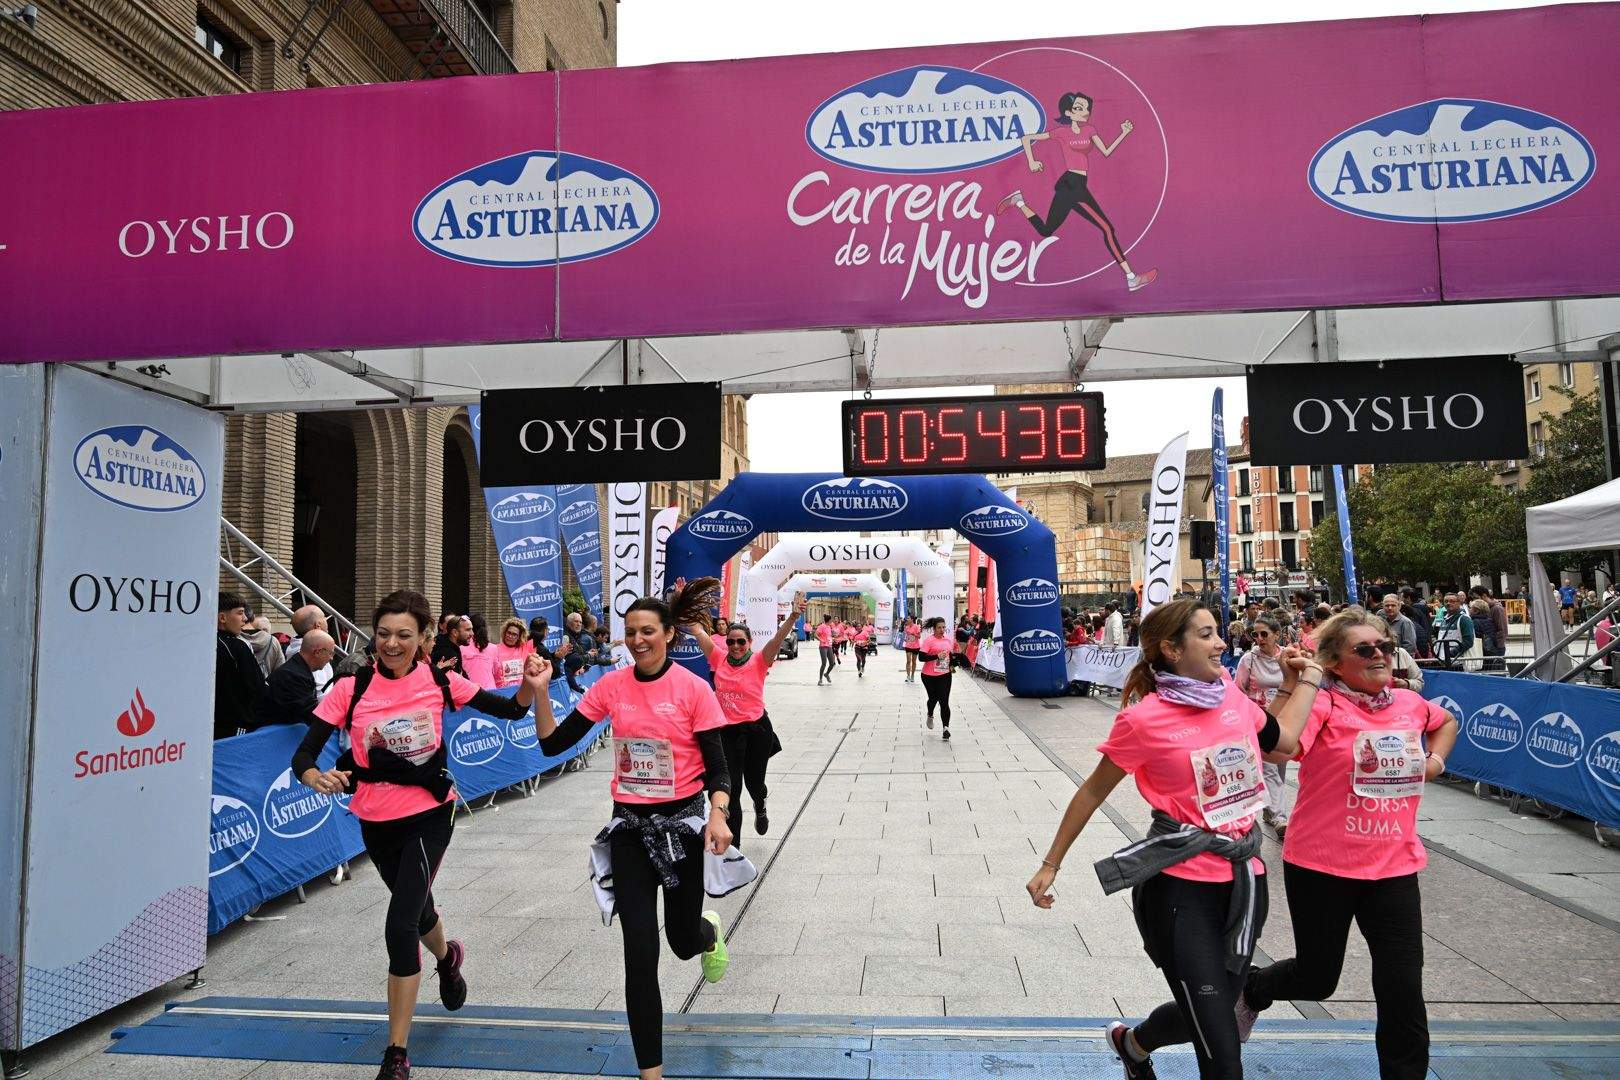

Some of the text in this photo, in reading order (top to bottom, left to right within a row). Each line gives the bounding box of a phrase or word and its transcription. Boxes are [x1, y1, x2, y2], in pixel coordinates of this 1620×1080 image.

[861, 98, 1019, 116] CENTRAL LECHERA
[824, 110, 1026, 150] ASTURIANA
[1373, 136, 1563, 158] CENTRAL LECHERA
[1331, 150, 1575, 195] ASTURIANA
[469, 186, 633, 205] CENTRAL LECHERA
[787, 171, 983, 226] Carrera
[431, 199, 640, 241] ASTURIANA
[118, 212, 295, 257] OYSHO
[835, 211, 1060, 308] de la Mujer
[1292, 392, 1485, 434] OYSHO
[519, 416, 687, 454] OYSHO
[84, 445, 198, 498] ASTURIANA
[107, 447, 195, 474] CENTRAL LECHERA
[810, 491, 900, 510] ASTURIANA
[692, 521, 748, 533] ASTURIANA
[966, 517, 1024, 530] ASTURIANA
[1146, 464, 1182, 606] OYSHO
[809, 544, 891, 561] OYSHO
[69, 573, 202, 615] OYSHO
[1008, 588, 1056, 600] ASTURIANA
[1012, 638, 1060, 651] ASTURIANA
[1085, 648, 1126, 668] OYSHO
[389, 735, 413, 747] 016
[1469, 717, 1517, 743] ASTURIANA
[74, 739, 186, 778] Santander
[456, 735, 502, 759] ASTURIANA
[633, 760, 654, 770] 016
[1381, 757, 1405, 768] 016
[1220, 769, 1245, 785] 016
[271, 791, 330, 829] ASTURIANA
[1345, 816, 1403, 834] SUMA
